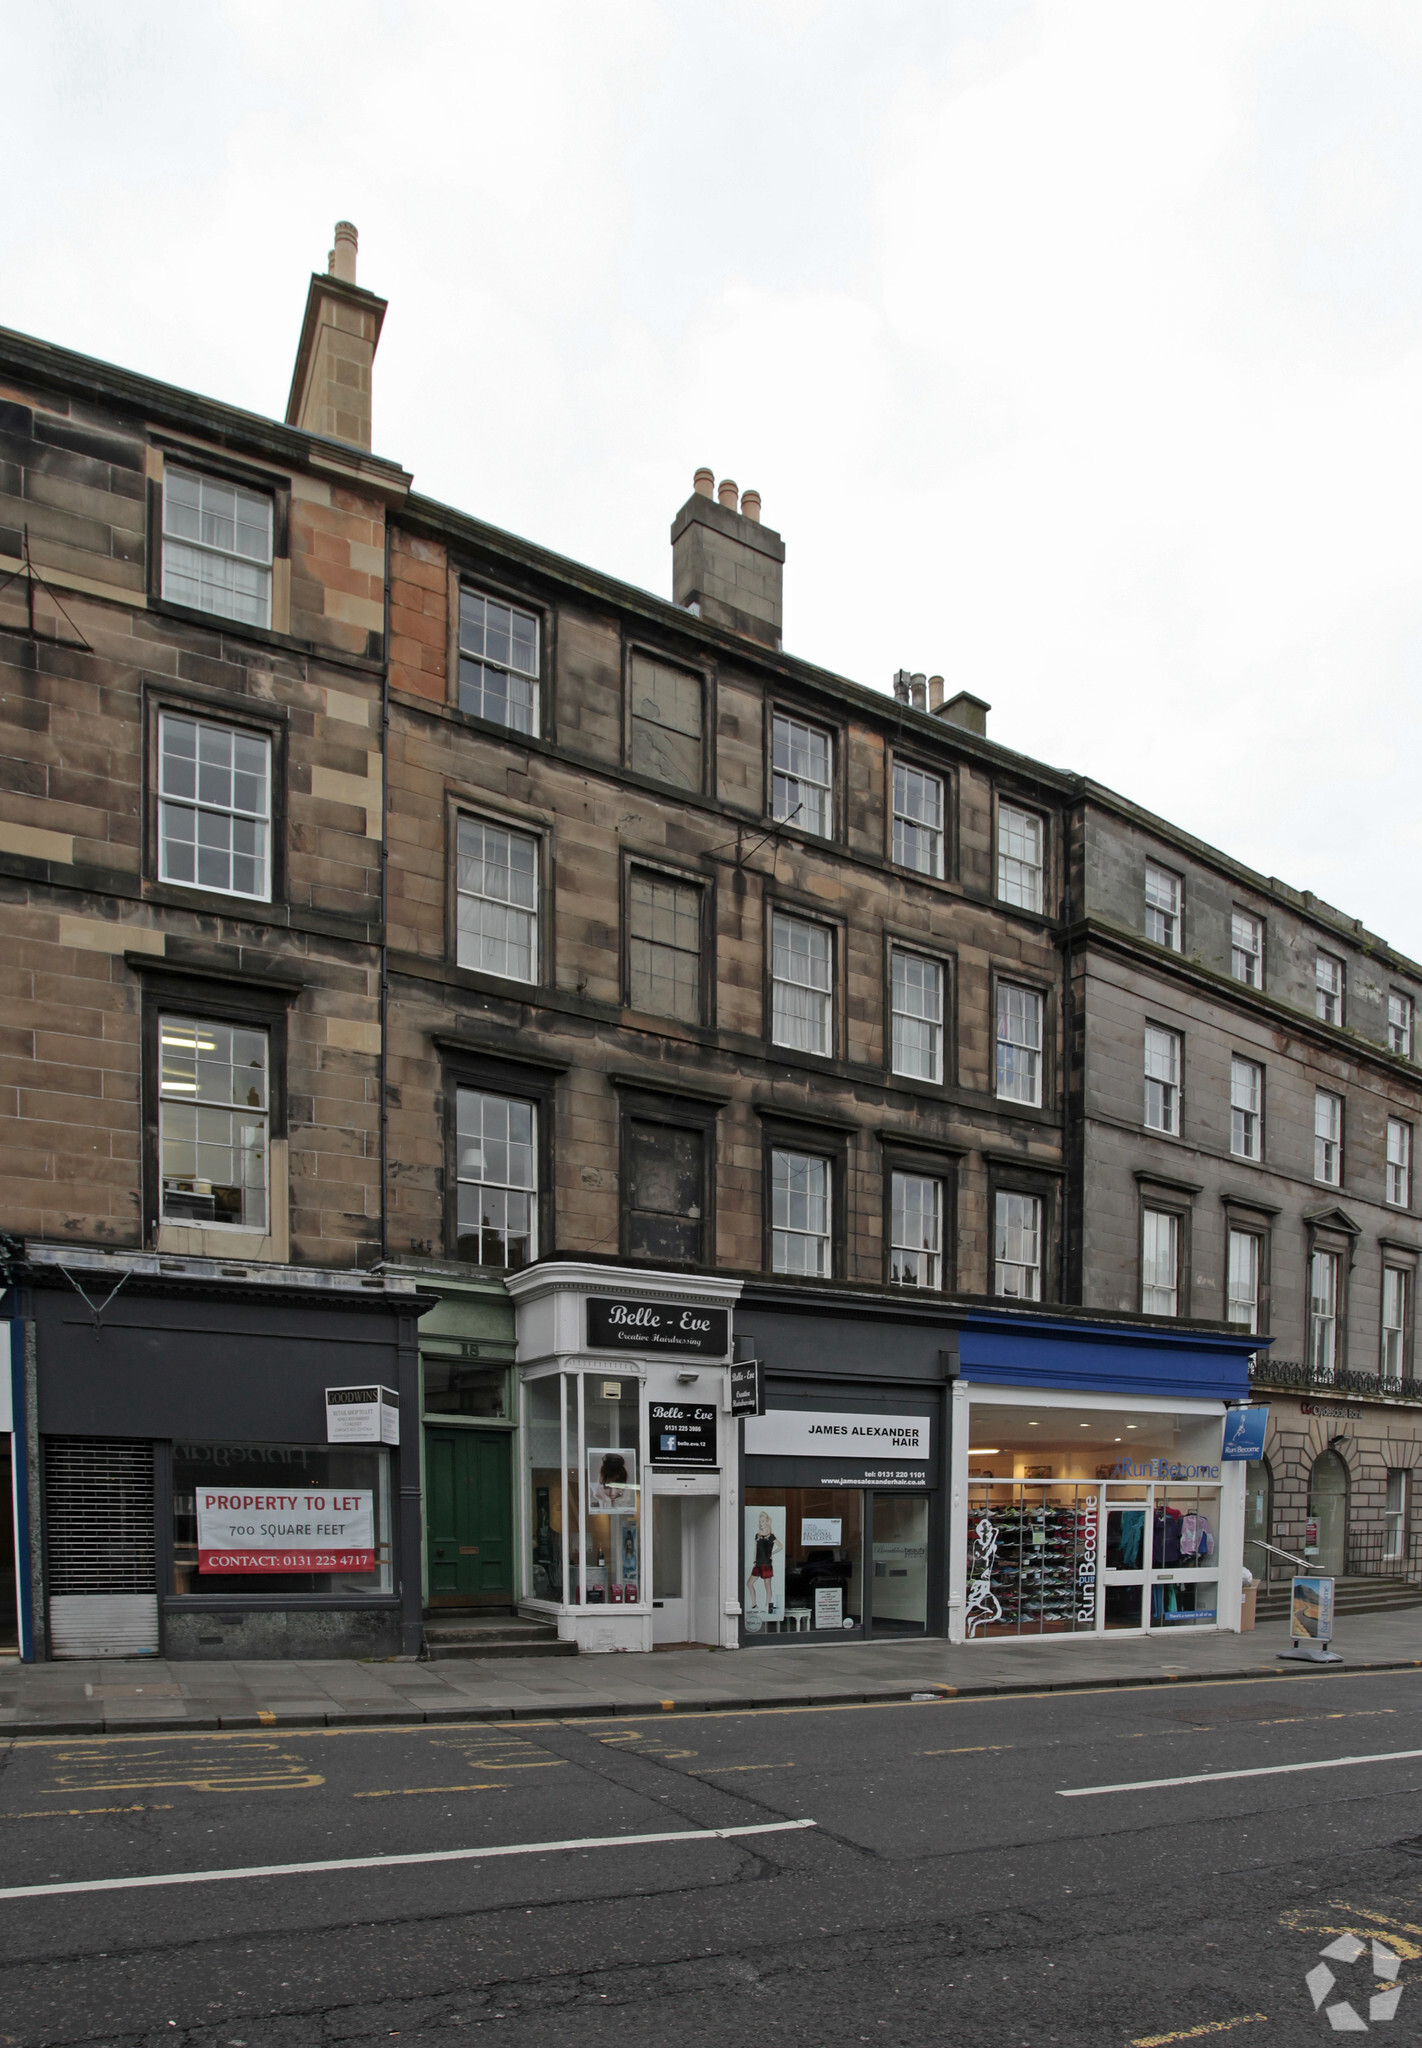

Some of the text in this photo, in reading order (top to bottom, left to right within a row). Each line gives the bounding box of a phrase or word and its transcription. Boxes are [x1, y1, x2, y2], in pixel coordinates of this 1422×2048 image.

[608, 1305, 661, 1328] Belle
[680, 1311, 711, 1331] Eve
[618, 1331, 702, 1347] Creative Hairdressing
[328, 1390, 378, 1404] GOODWINS
[652, 1406, 684, 1419] Belle
[694, 1408, 713, 1420] Eve
[1312, 1404, 1363, 1419] Clydesdale Bank
[808, 1425, 919, 1437] JAMES ALEXANDER
[892, 1438, 919, 1447] HAIR
[1122, 1457, 1152, 1477] Run
[1159, 1459, 1219, 1478] Become
[821, 1478, 926, 1486] www.jamesalexanderhair.co.uk
[205, 1495, 362, 1511] PROPERTY TO LET
[229, 1524, 346, 1538] 700 SQUARE FEET
[1079, 1495, 1098, 1576] Become
[208, 1555, 368, 1567] CONTACT: 0131 225 4717
[1077, 1584, 1095, 1622] Run
